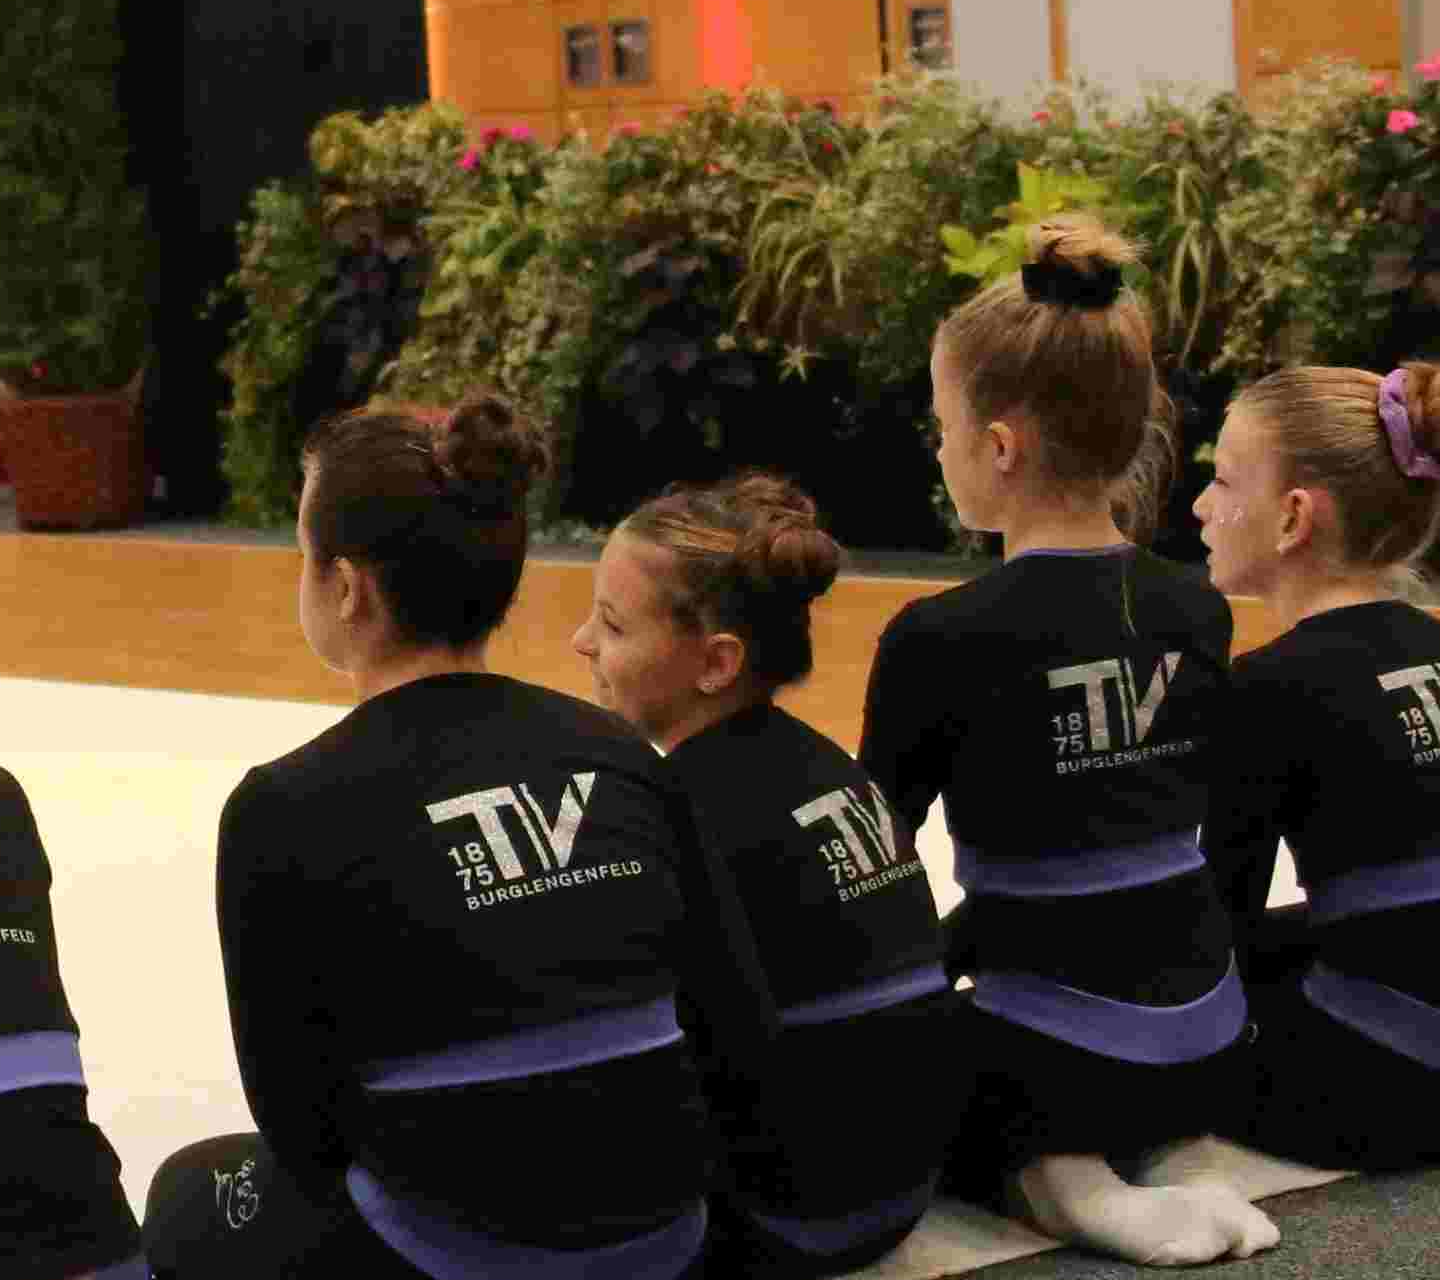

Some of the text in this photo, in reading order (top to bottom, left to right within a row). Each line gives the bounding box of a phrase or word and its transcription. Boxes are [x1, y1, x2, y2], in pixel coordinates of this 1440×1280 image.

[1047, 651, 1183, 752] TV
[1052, 712, 1083, 733] 18
[1398, 706, 1424, 728] 18
[1054, 734, 1085, 755] 75
[1404, 724, 1432, 747] 75
[425, 771, 596, 880] TV
[791, 781, 897, 877] TV
[448, 841, 485, 868] 18
[819, 838, 847, 862] 18
[455, 864, 495, 892] 75
[466, 858, 643, 911] BURGLENGENFELD
[827, 858, 857, 886] 75
